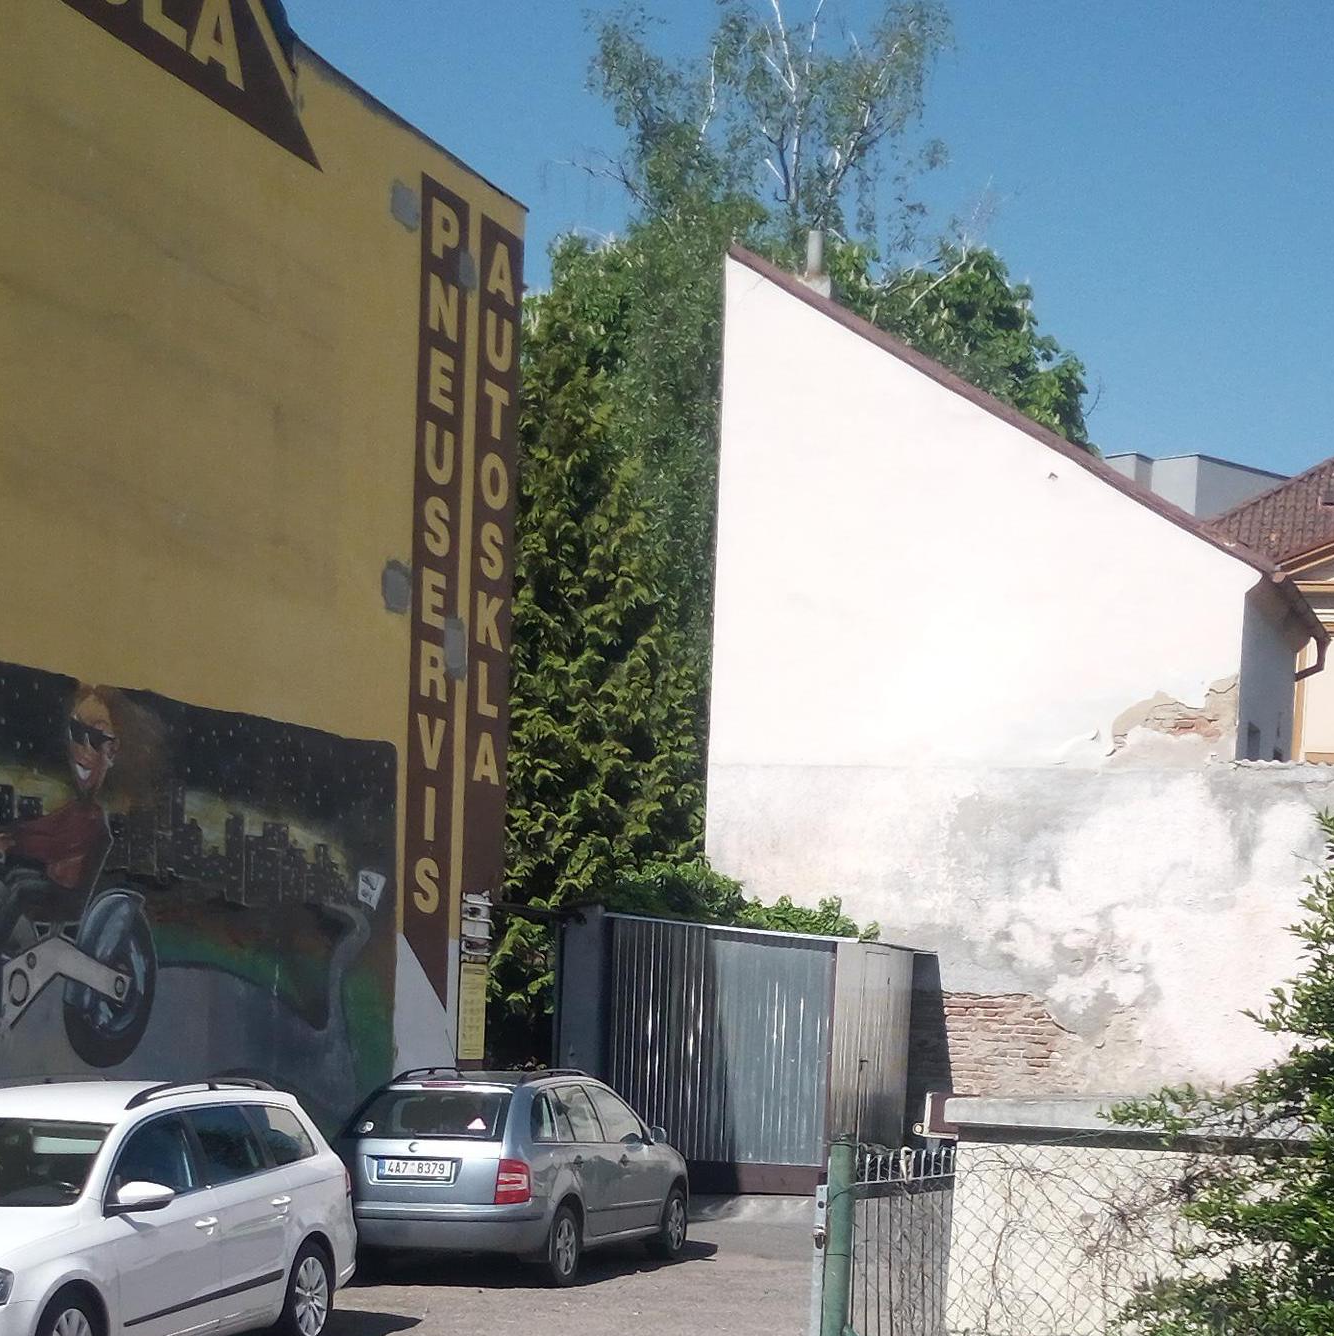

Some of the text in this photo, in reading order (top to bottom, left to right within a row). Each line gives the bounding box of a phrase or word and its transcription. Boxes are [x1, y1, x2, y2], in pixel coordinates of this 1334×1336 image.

[413, 197, 460, 915] PNEUSERVIS
[472, 241, 515, 786] AUTOSKLA
[417, 1162, 445, 1174] 8379
